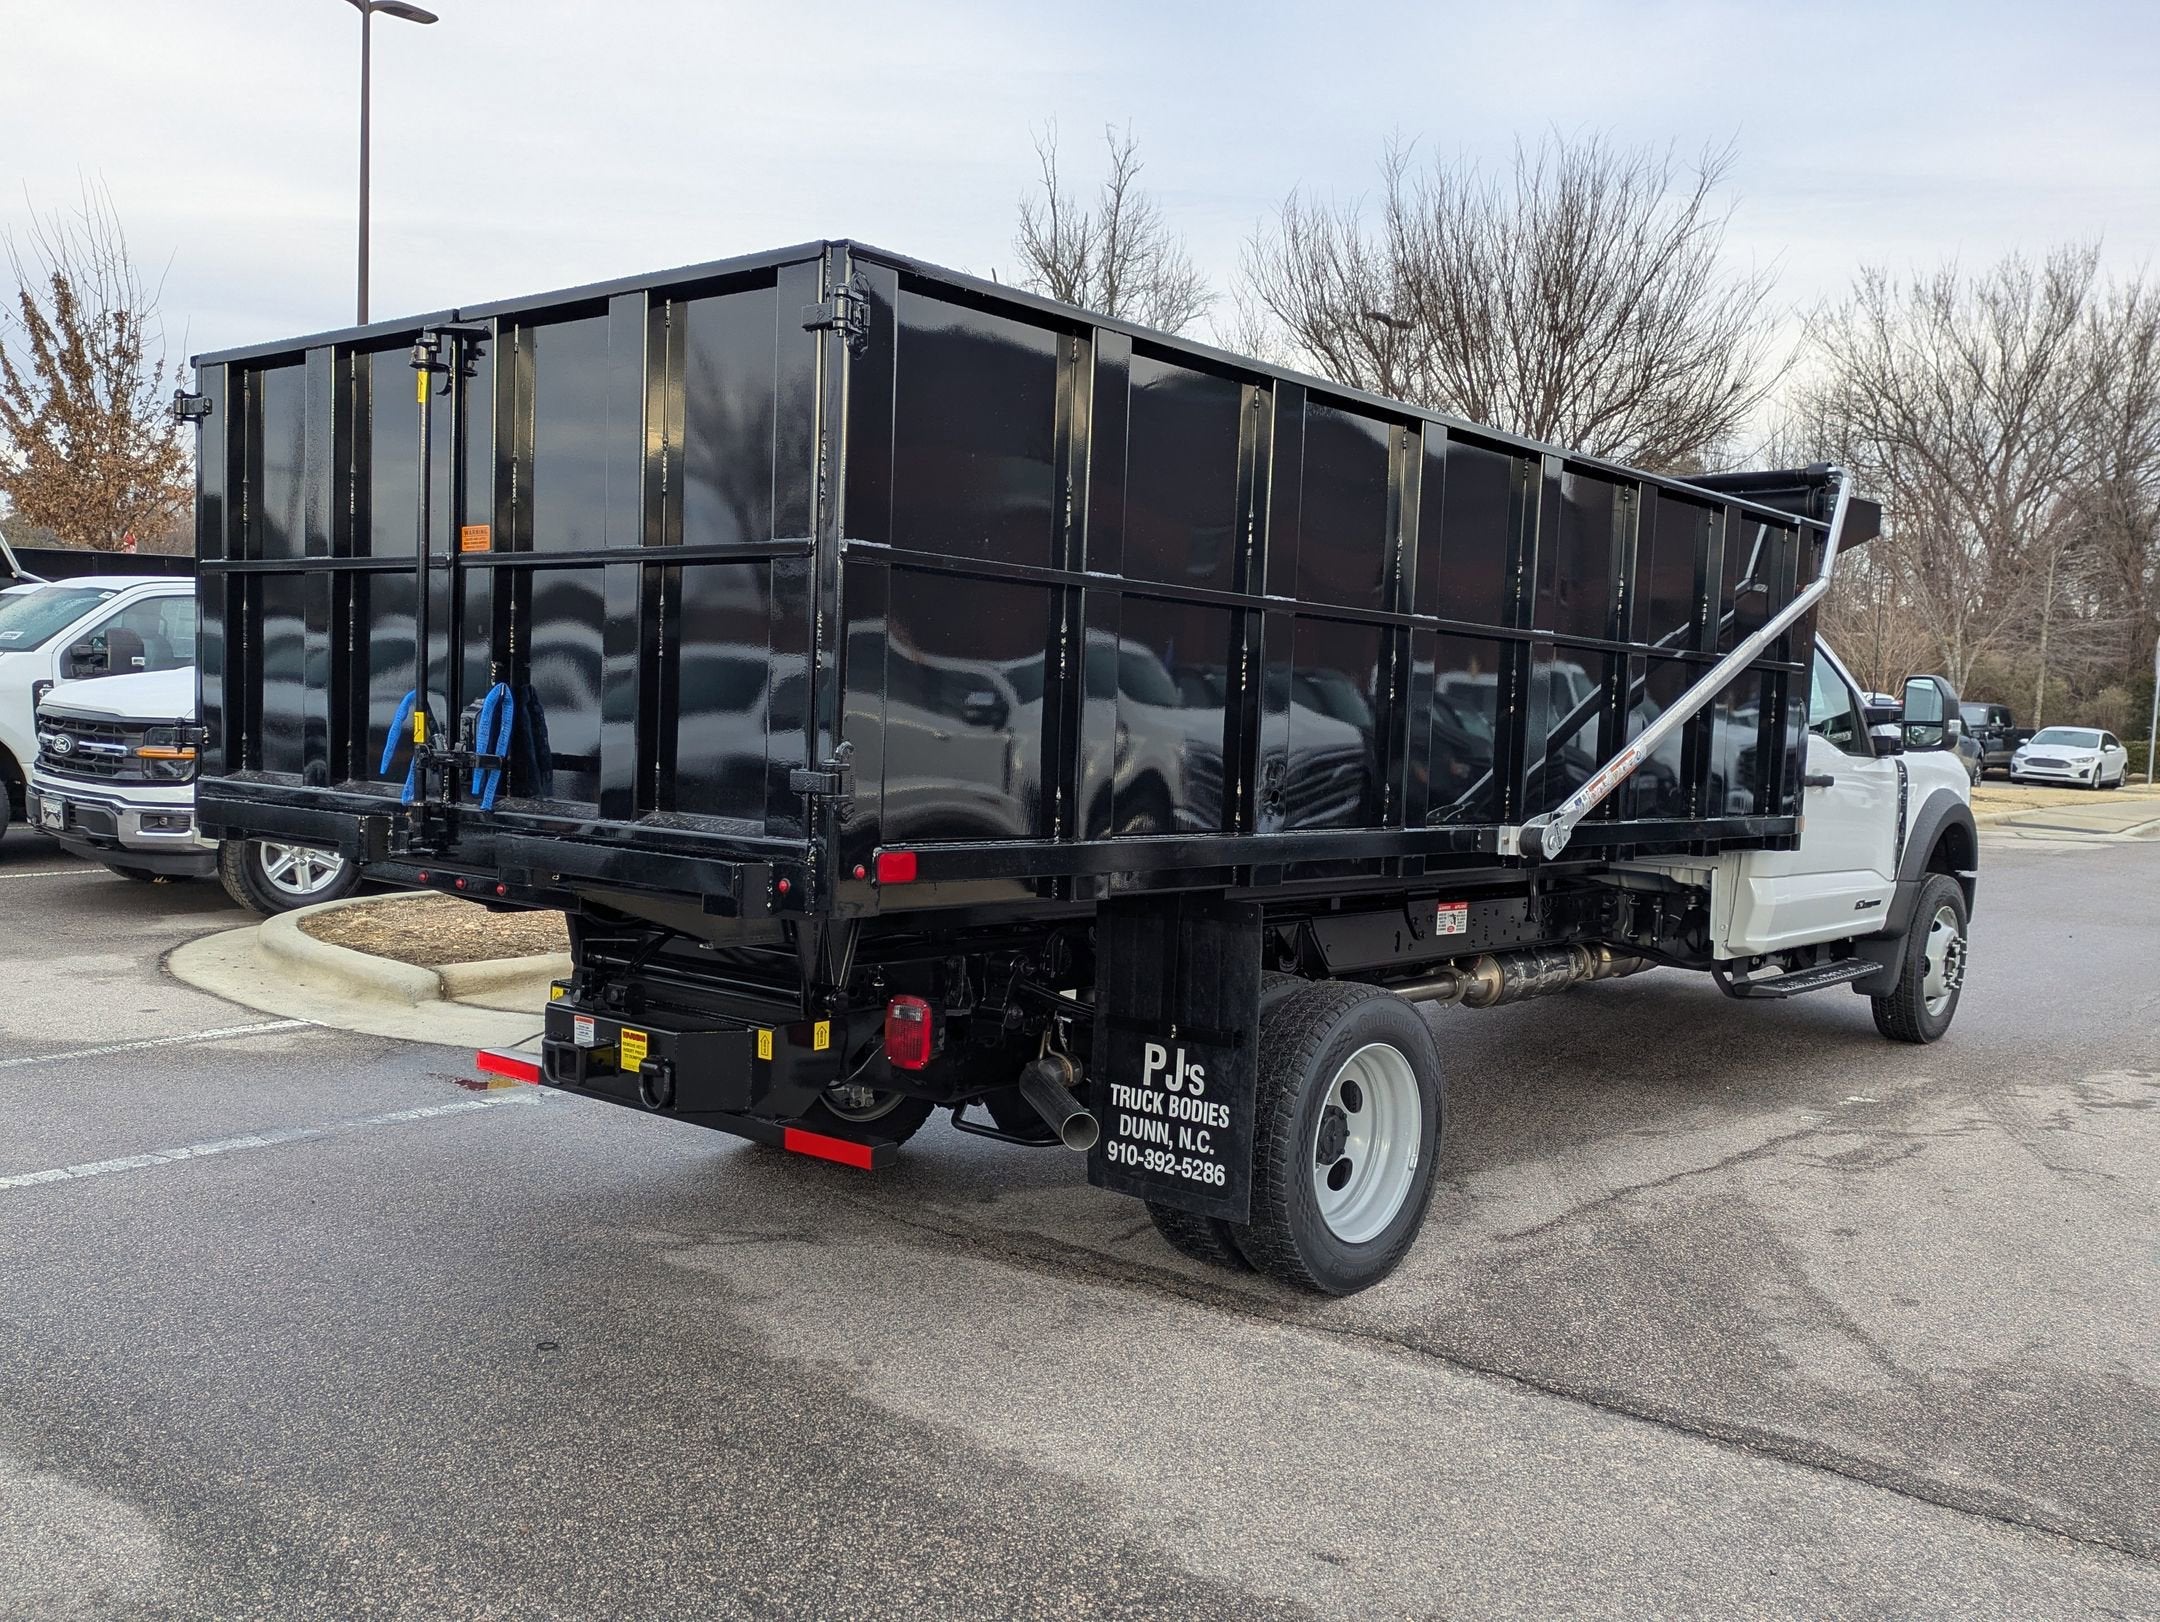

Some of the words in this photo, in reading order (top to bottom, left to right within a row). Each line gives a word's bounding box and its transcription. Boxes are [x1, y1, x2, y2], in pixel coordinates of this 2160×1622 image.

[1110, 1083, 1165, 1115] TRUCK
[1168, 1094, 1230, 1128] BODIES
[1119, 1114, 1173, 1150] DUNN,
[1178, 1126, 1215, 1155] N.C.
[1107, 1140, 1226, 1186] 910-392-5286
